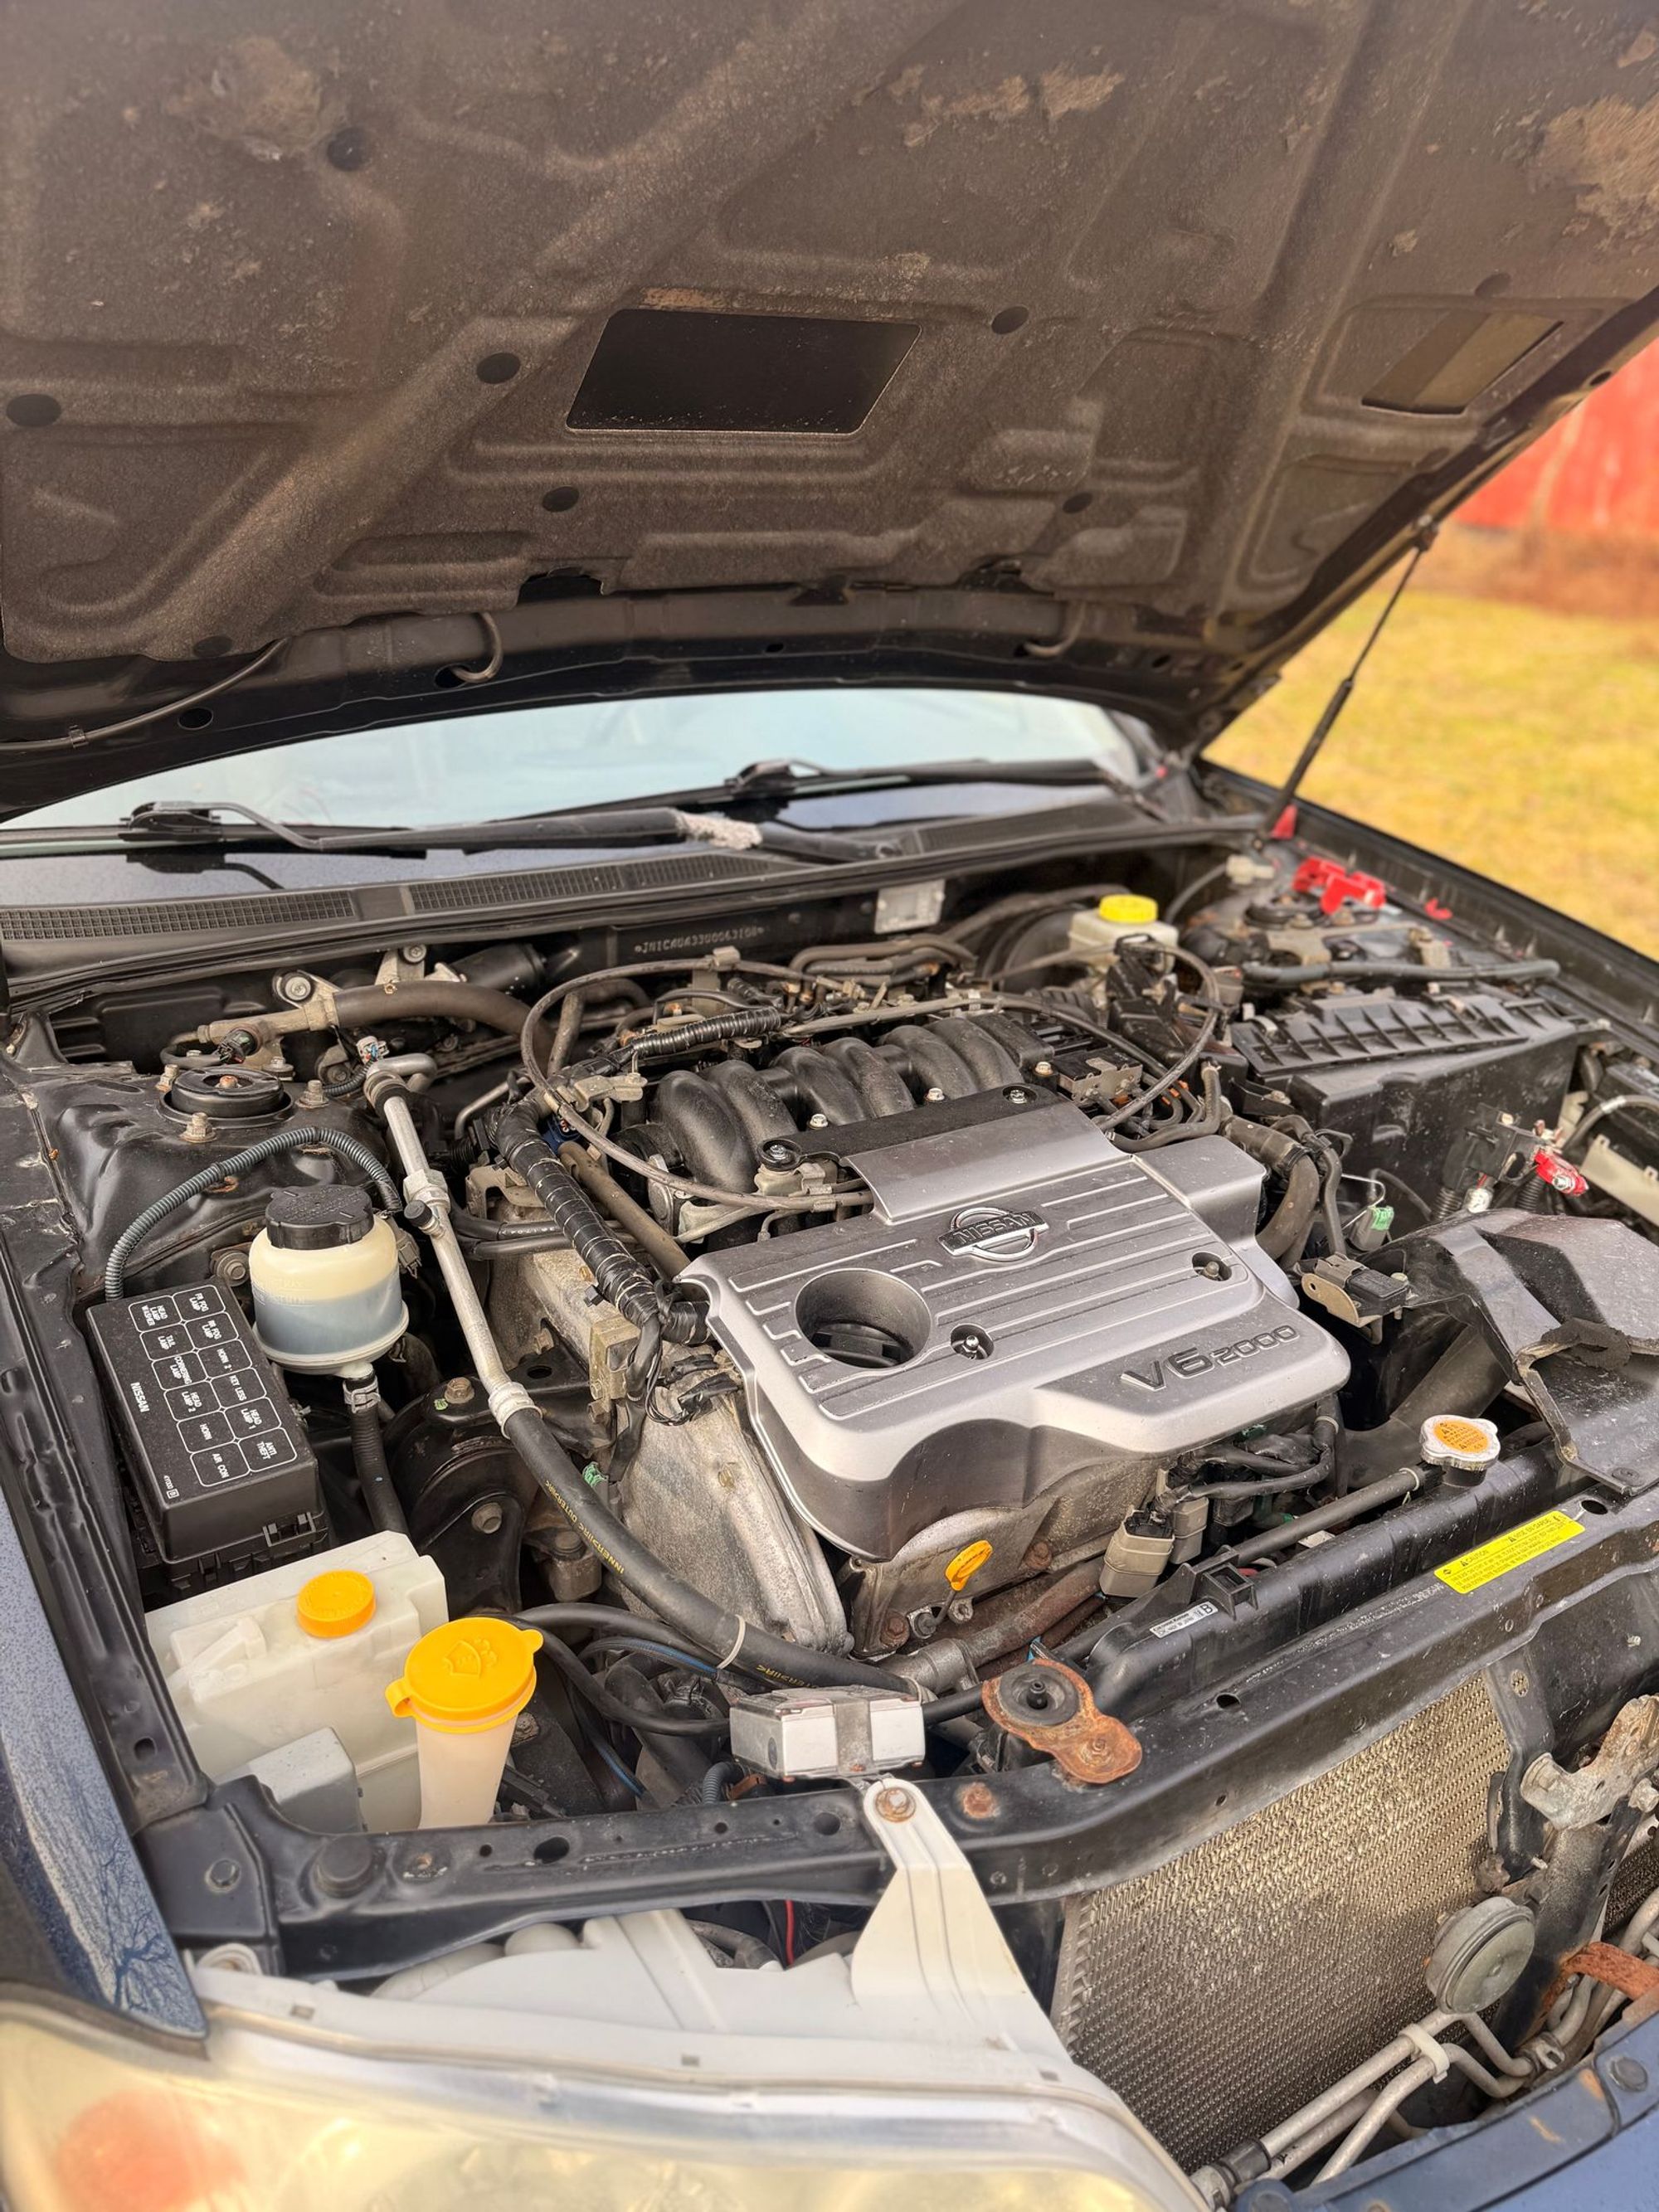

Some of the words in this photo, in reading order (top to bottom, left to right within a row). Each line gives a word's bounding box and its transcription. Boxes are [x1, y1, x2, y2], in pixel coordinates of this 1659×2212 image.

[951, 1213, 1036, 1244] NISSAN
[188, 1296, 200, 1310] LAMP
[198, 1300, 208, 1311] FOG
[141, 1305, 155, 1325] WASHER
[149, 1306, 160, 1320] LAMP
[156, 1305, 168, 1319] HEAD
[202, 1324, 213, 1338] LAMP
[211, 1327, 221, 1339] FOG
[158, 1335, 169, 1349] LAMP
[165, 1334, 175, 1347] TAIL
[216, 1348, 229, 1363] HORN
[1121, 1346, 1215, 1392] V6
[1210, 1325, 1300, 1366] 2000
[169, 1364, 182, 1378] LAMP
[173, 1354, 192, 1385] CORNERING
[229, 1374, 240, 1385] KEY
[130, 1382, 149, 1412] NISSAN
[181, 1391, 193, 1406] LAMP
[190, 1392, 202, 1407] HEAD
[234, 1386, 246, 1401] LESS
[241, 1407, 253, 1423] LAMP
[249, 1408, 262, 1424] HEAD
[199, 1423, 212, 1440] HORN
[256, 1441, 270, 1459] THEFT
[265, 1441, 277, 1455] ANTI
[212, 1453, 222, 1463] AIR
[216, 1464, 229, 1478] CON
[1199, 1604, 1213, 1614] B
